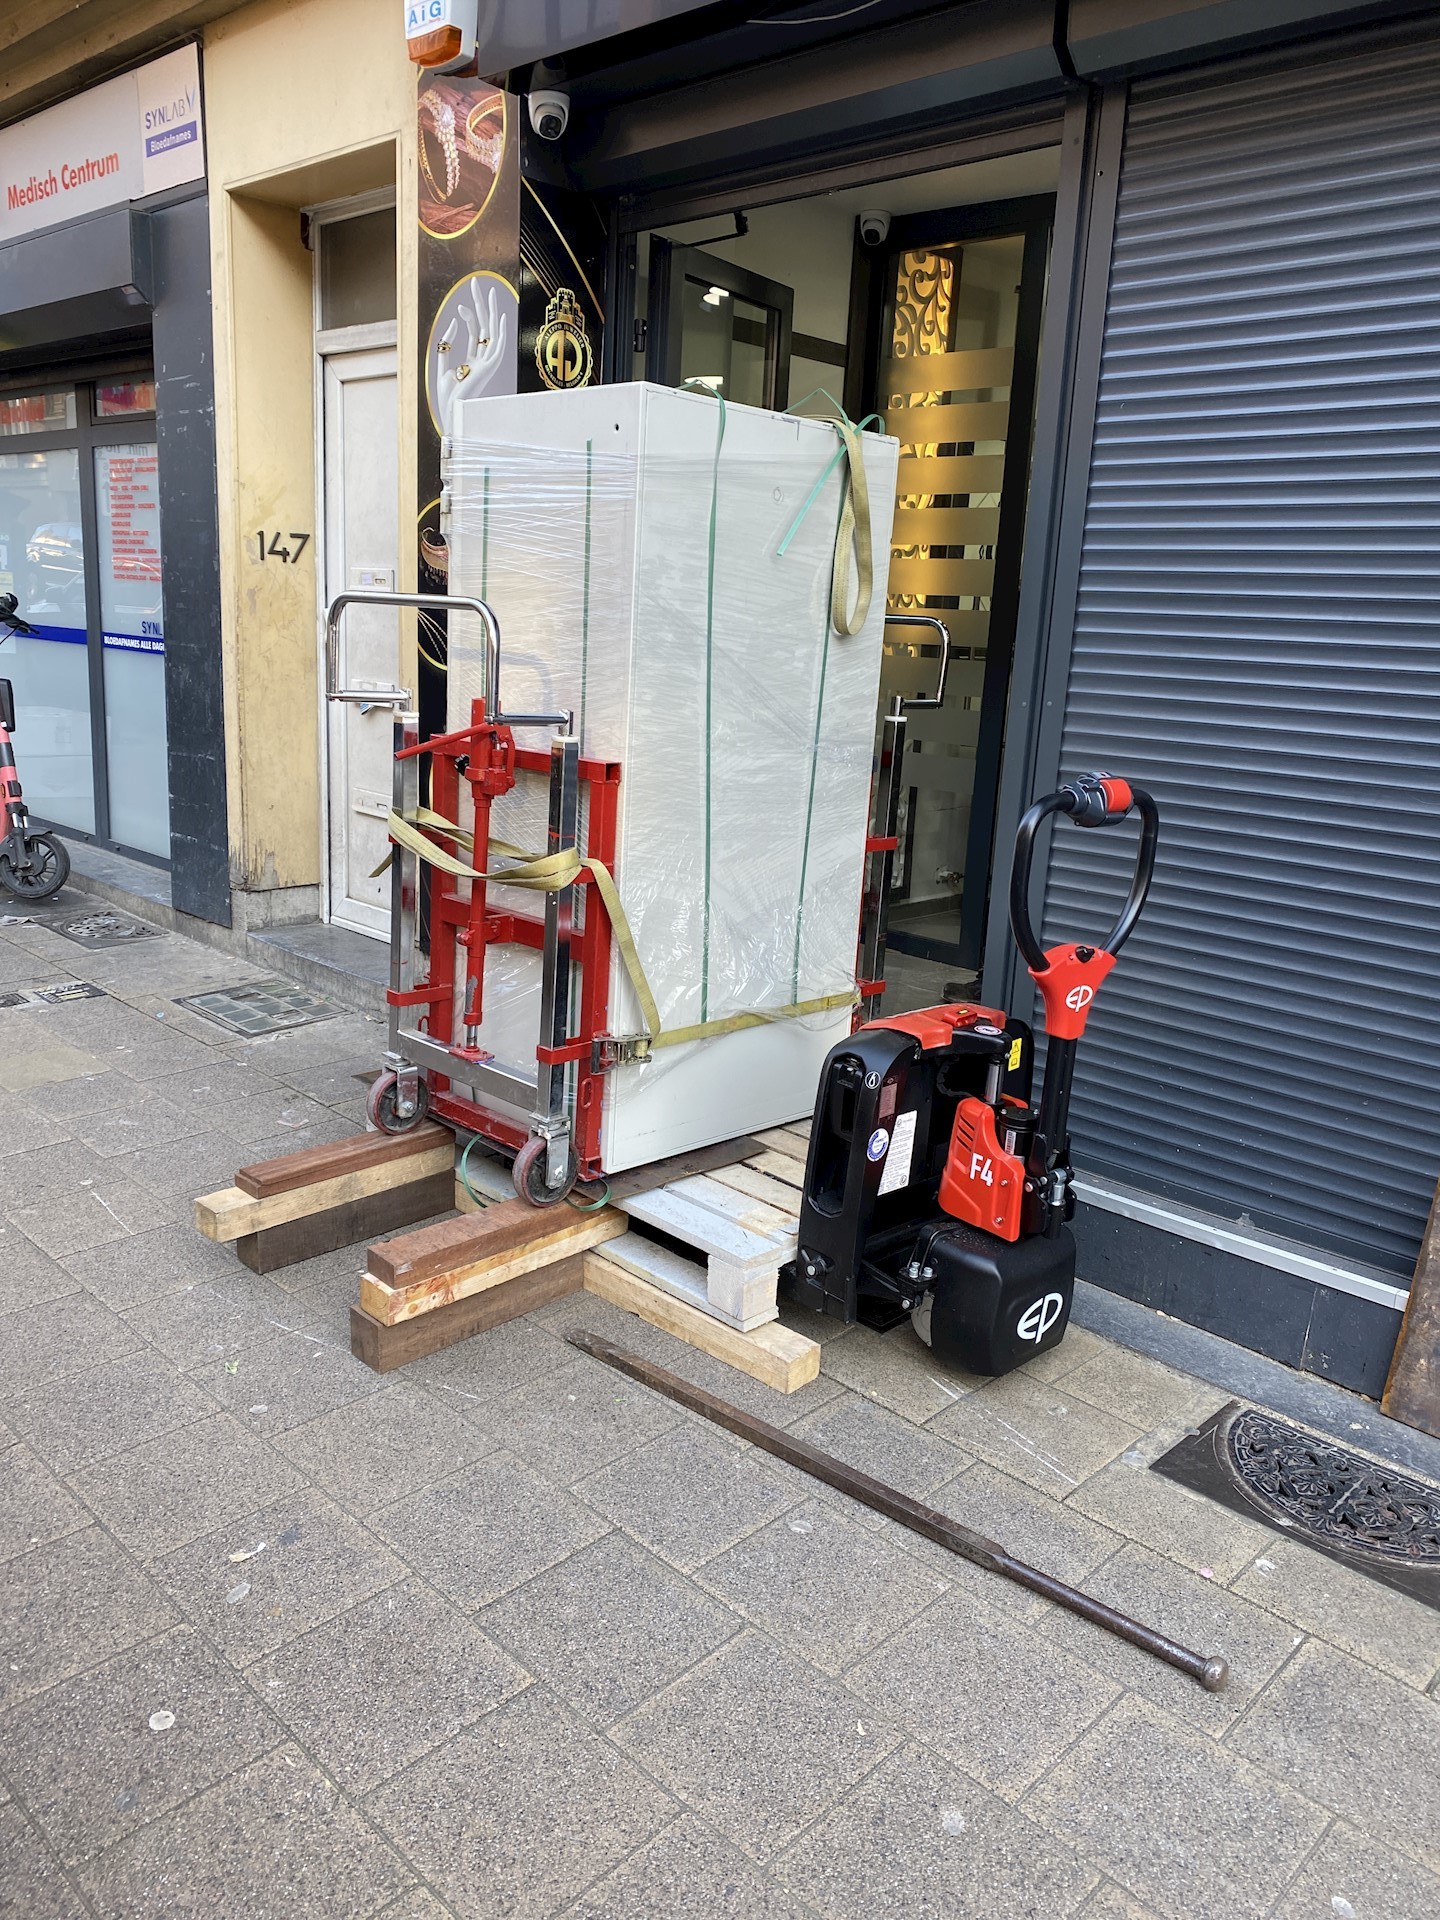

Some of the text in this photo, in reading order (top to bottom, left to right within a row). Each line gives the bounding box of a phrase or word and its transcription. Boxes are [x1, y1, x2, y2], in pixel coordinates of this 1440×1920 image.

[145, 99, 185, 129] SYNLAB
[150, 130, 192, 153] Bloedafnames
[8, 153, 119, 210] Medisch Centrum
[256, 530, 311, 563] 147
[104, 636, 140, 649] BLOEDAFNAMES
[141, 640, 151, 650] ALLE
[1066, 985, 1093, 1013] EP
[970, 1152, 994, 1187] F4
[1017, 1292, 1064, 1345] EP
